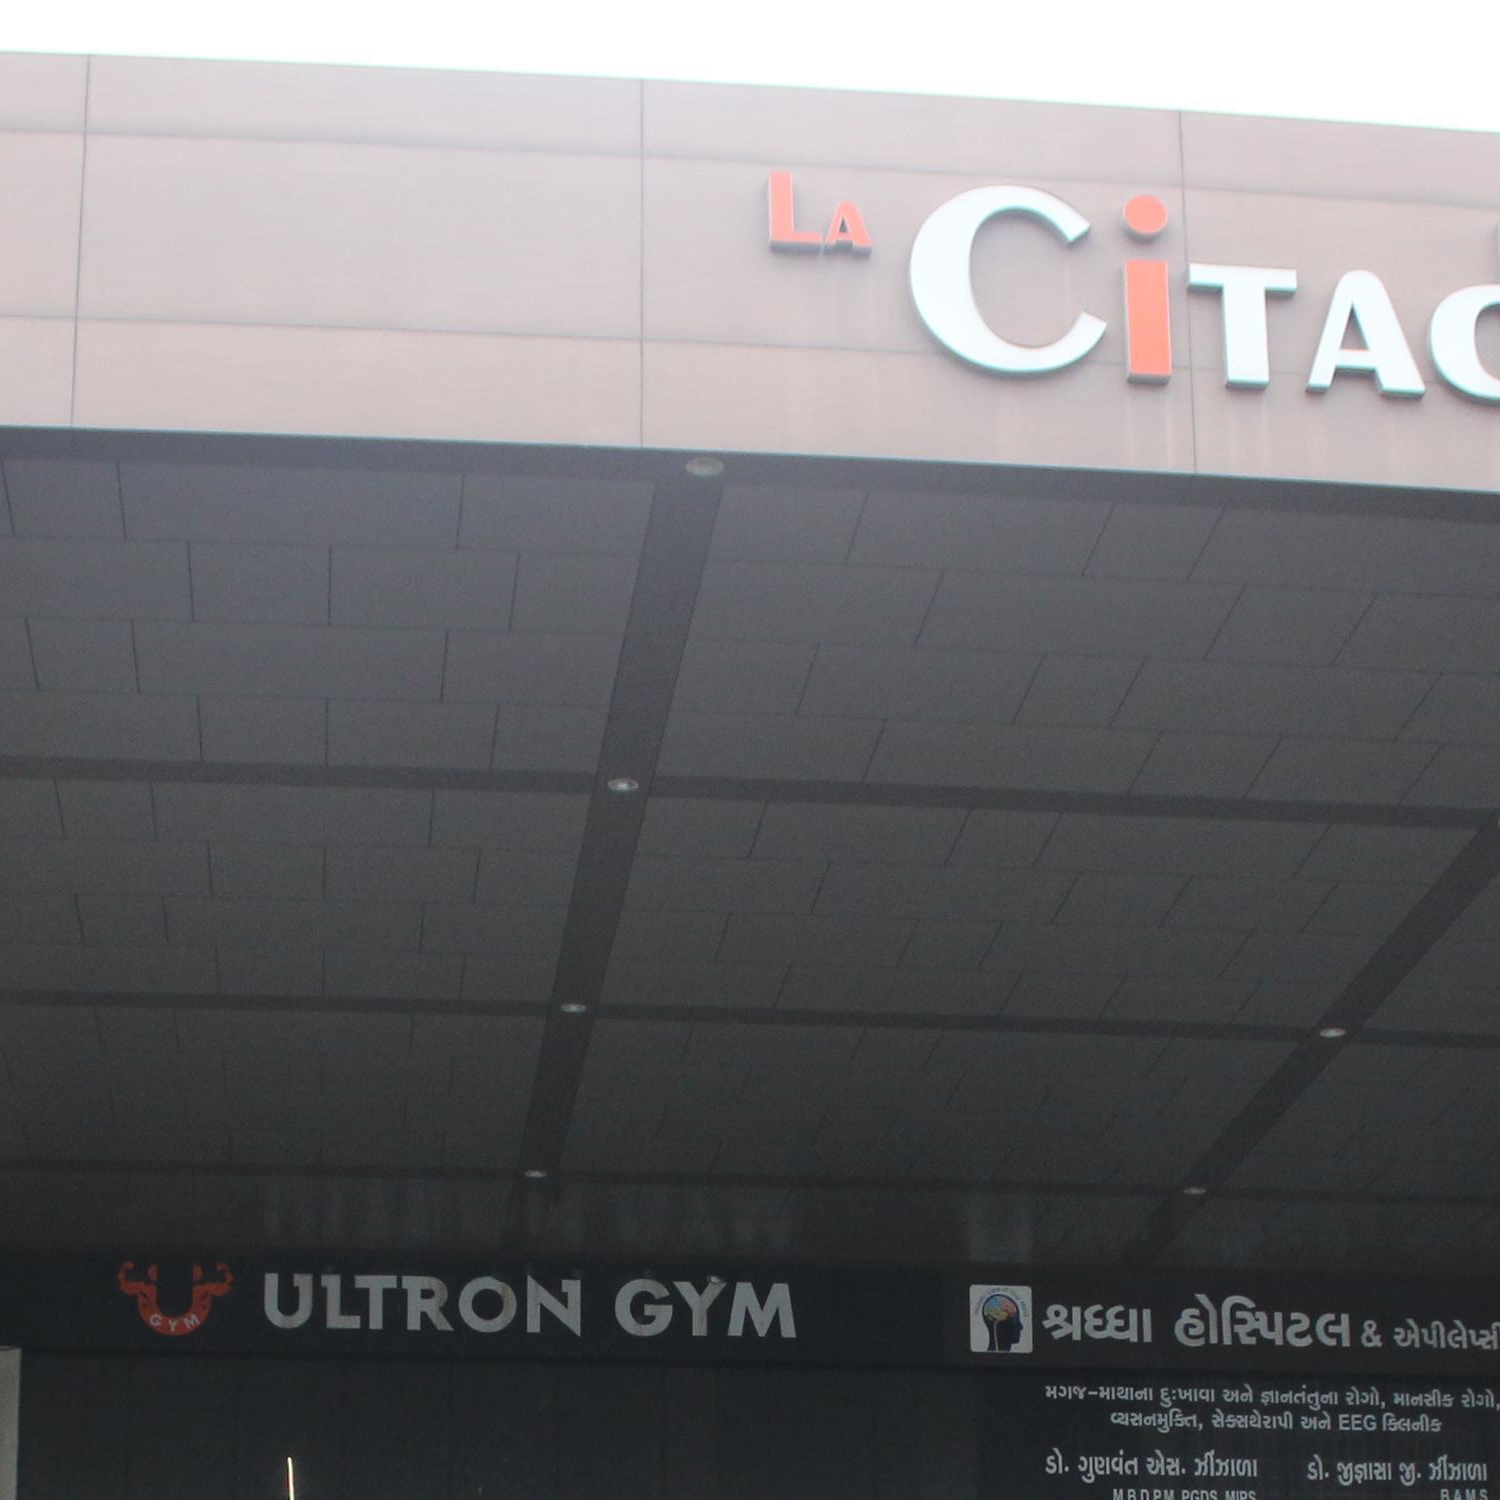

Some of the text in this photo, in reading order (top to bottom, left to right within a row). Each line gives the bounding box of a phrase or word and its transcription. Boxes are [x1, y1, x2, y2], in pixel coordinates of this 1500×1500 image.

[768, 171, 872, 256] LA
[263, 1274, 797, 1338] ULTRON GYM
[1174, 1293, 1350, 1347] હોસ્પિટલ
[1360, 1320, 1382, 1348] &
[1222, 1384, 1252, 1403] અને
[1301, 1412, 1376, 1430] અને EEG
